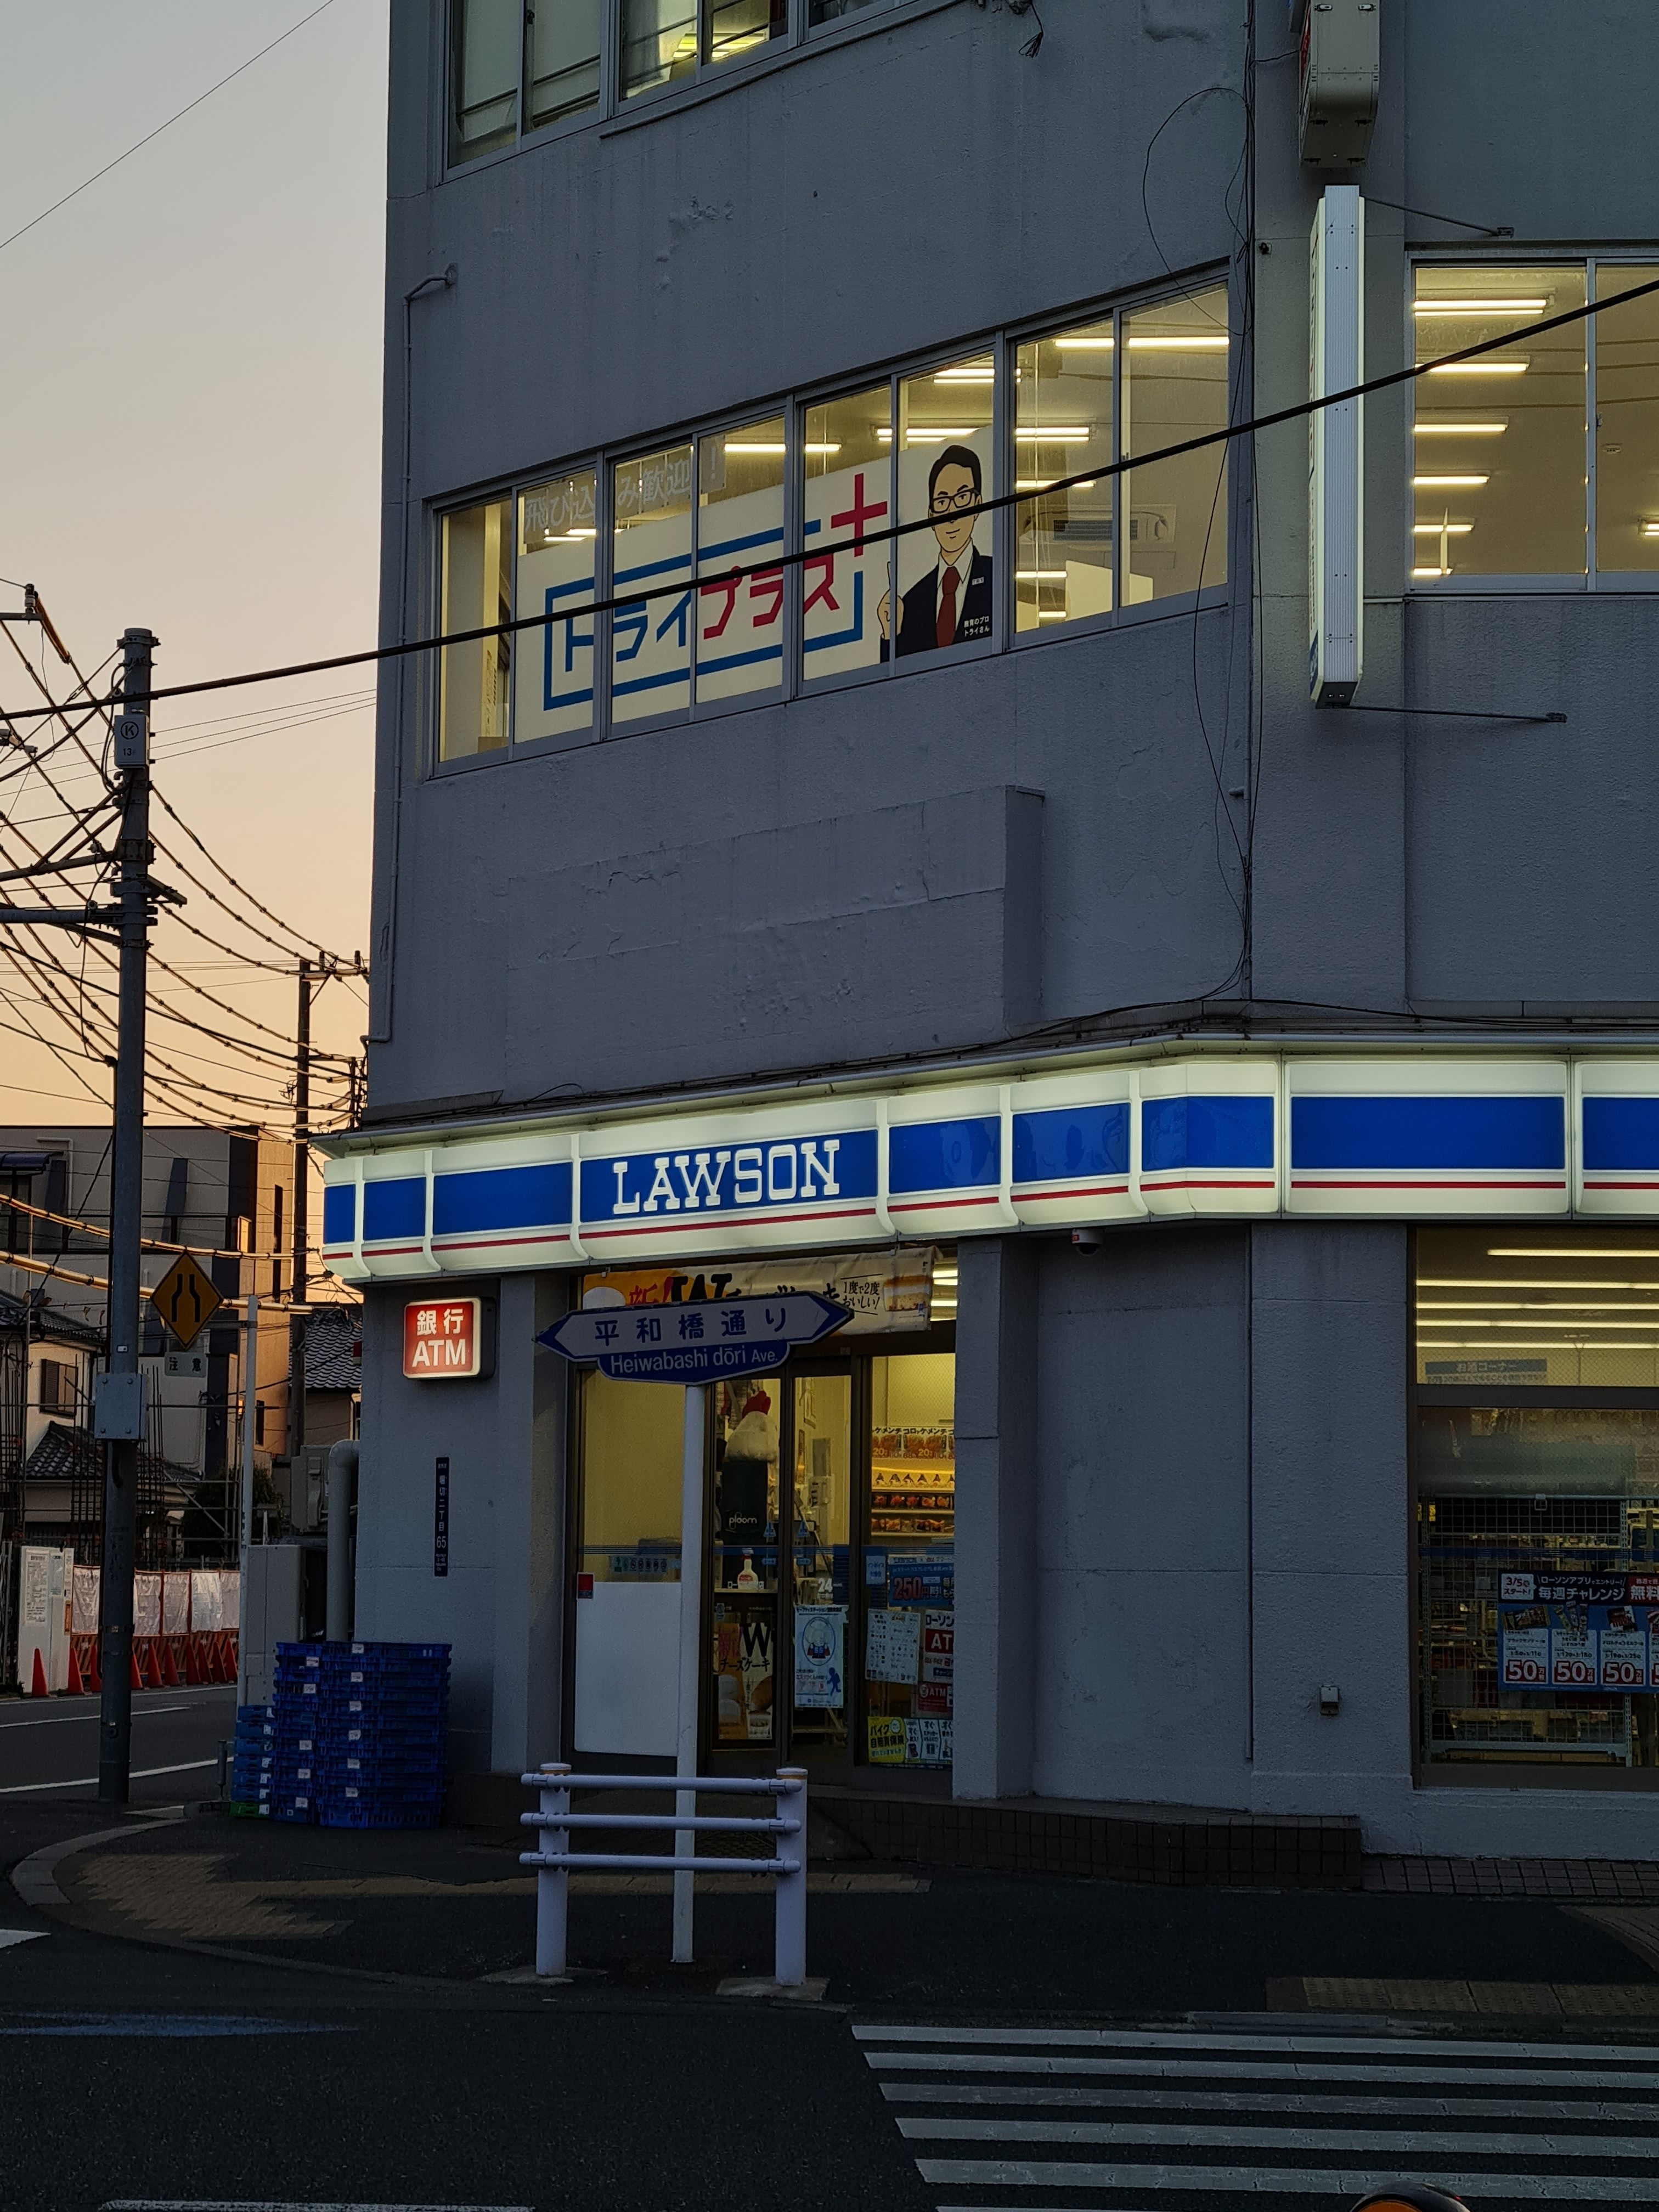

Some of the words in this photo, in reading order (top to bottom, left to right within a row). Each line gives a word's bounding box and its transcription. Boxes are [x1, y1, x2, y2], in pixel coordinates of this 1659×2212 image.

[964, 616, 990, 628] 教育のプロ
[964, 625, 991, 637] トライさん
[613, 1139, 840, 1215] LAWSON
[844, 1281, 879, 1296] 1度で2度
[843, 1296, 879, 1311] おいしい!
[417, 1308, 464, 1336] 銀行
[594, 1307, 786, 1347] 平和橋通り
[411, 1338, 466, 1368] ATM
[611, 1347, 708, 1374] Heiwabashi
[714, 1346, 747, 1365] dōri
[751, 1349, 778, 1363] Ave.
[169, 1357, 201, 1372] 注意
[729, 1511, 758, 1530] ploom
[436, 1536, 447, 1548] 65
[818, 1578, 833, 1593] 24
[1538, 1586, 1625, 1601] 毎週チャレンジ
[720, 1657, 771, 1672] チーズケーキ
[929, 1688, 946, 1697] ATM
[870, 1724, 890, 1736] バイク
